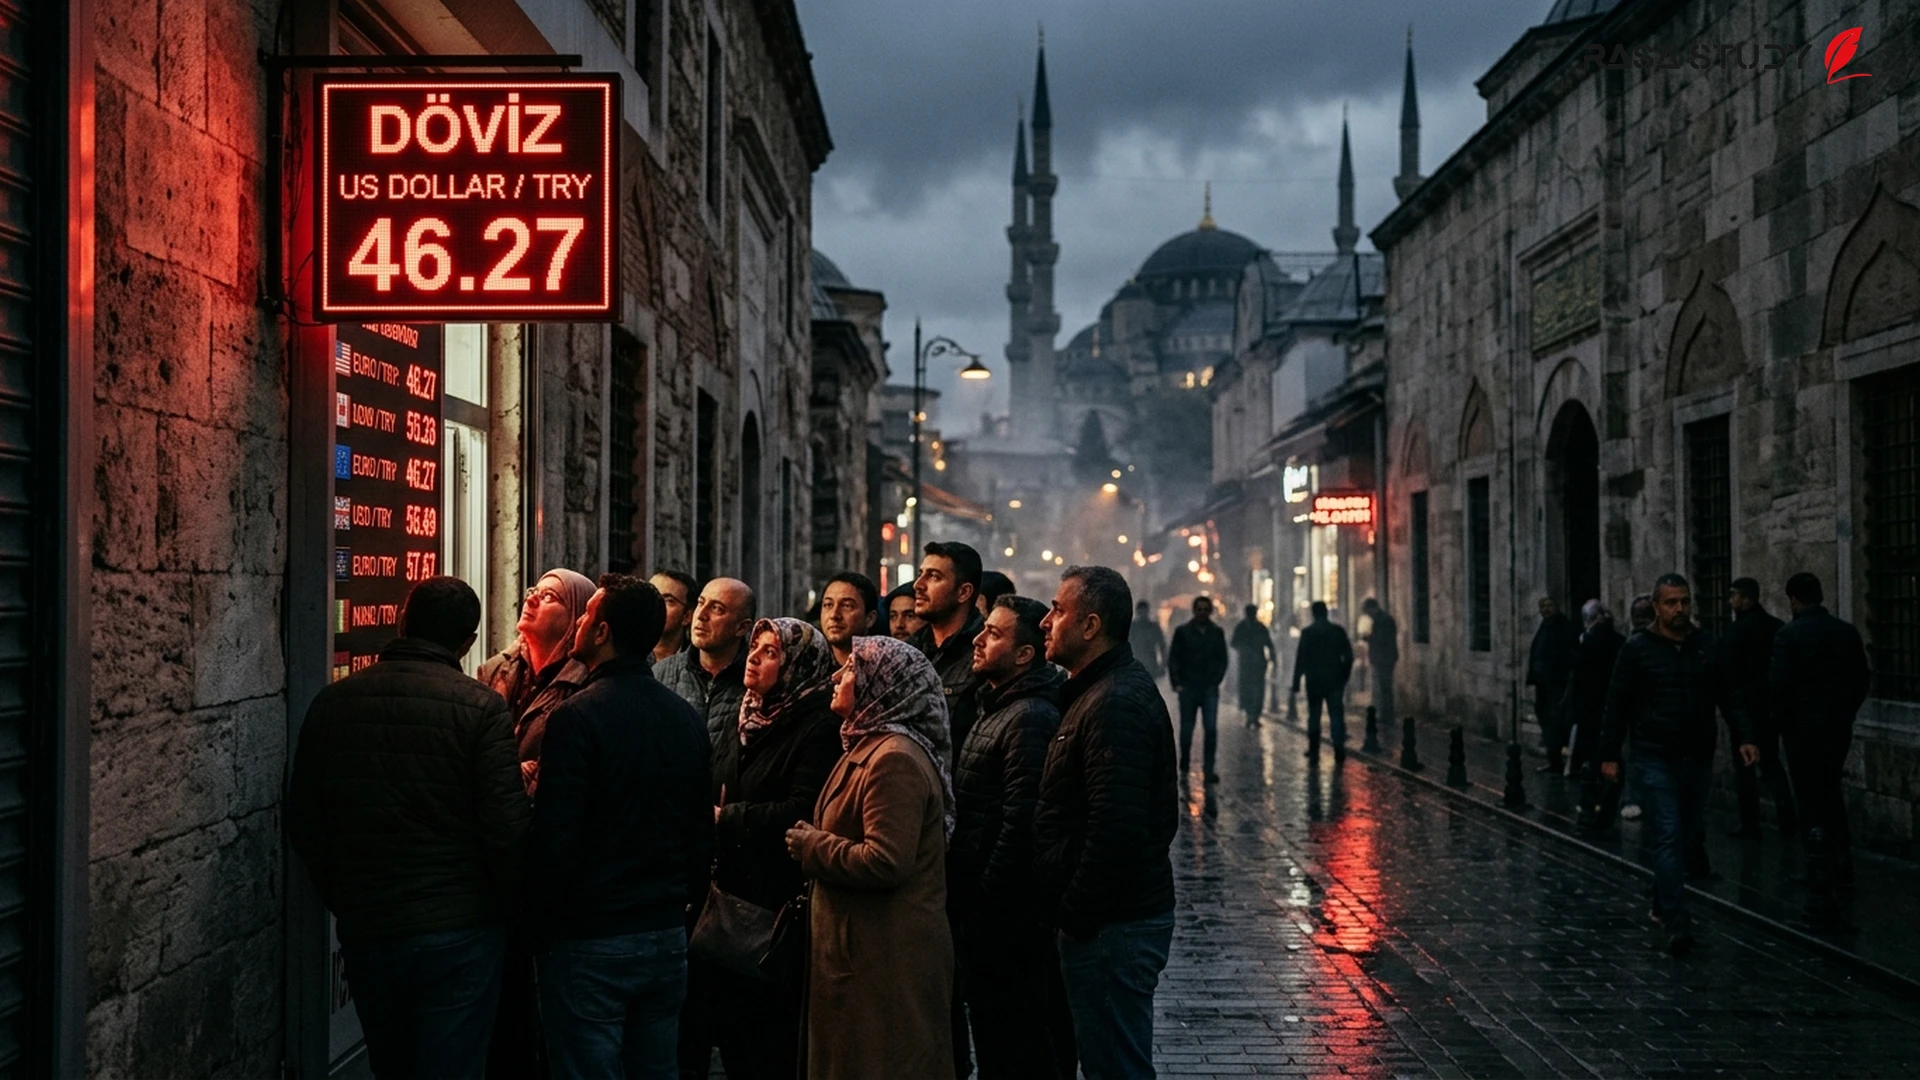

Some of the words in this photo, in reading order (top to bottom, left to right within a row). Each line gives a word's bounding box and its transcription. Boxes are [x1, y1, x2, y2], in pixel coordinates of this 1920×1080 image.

[371, 93, 562, 153] DÖVİZ
[339, 174, 379, 199] US
[389, 174, 506, 199] DOLLAR
[532, 174, 592, 199] TRY
[348, 217, 584, 291] 46.27
